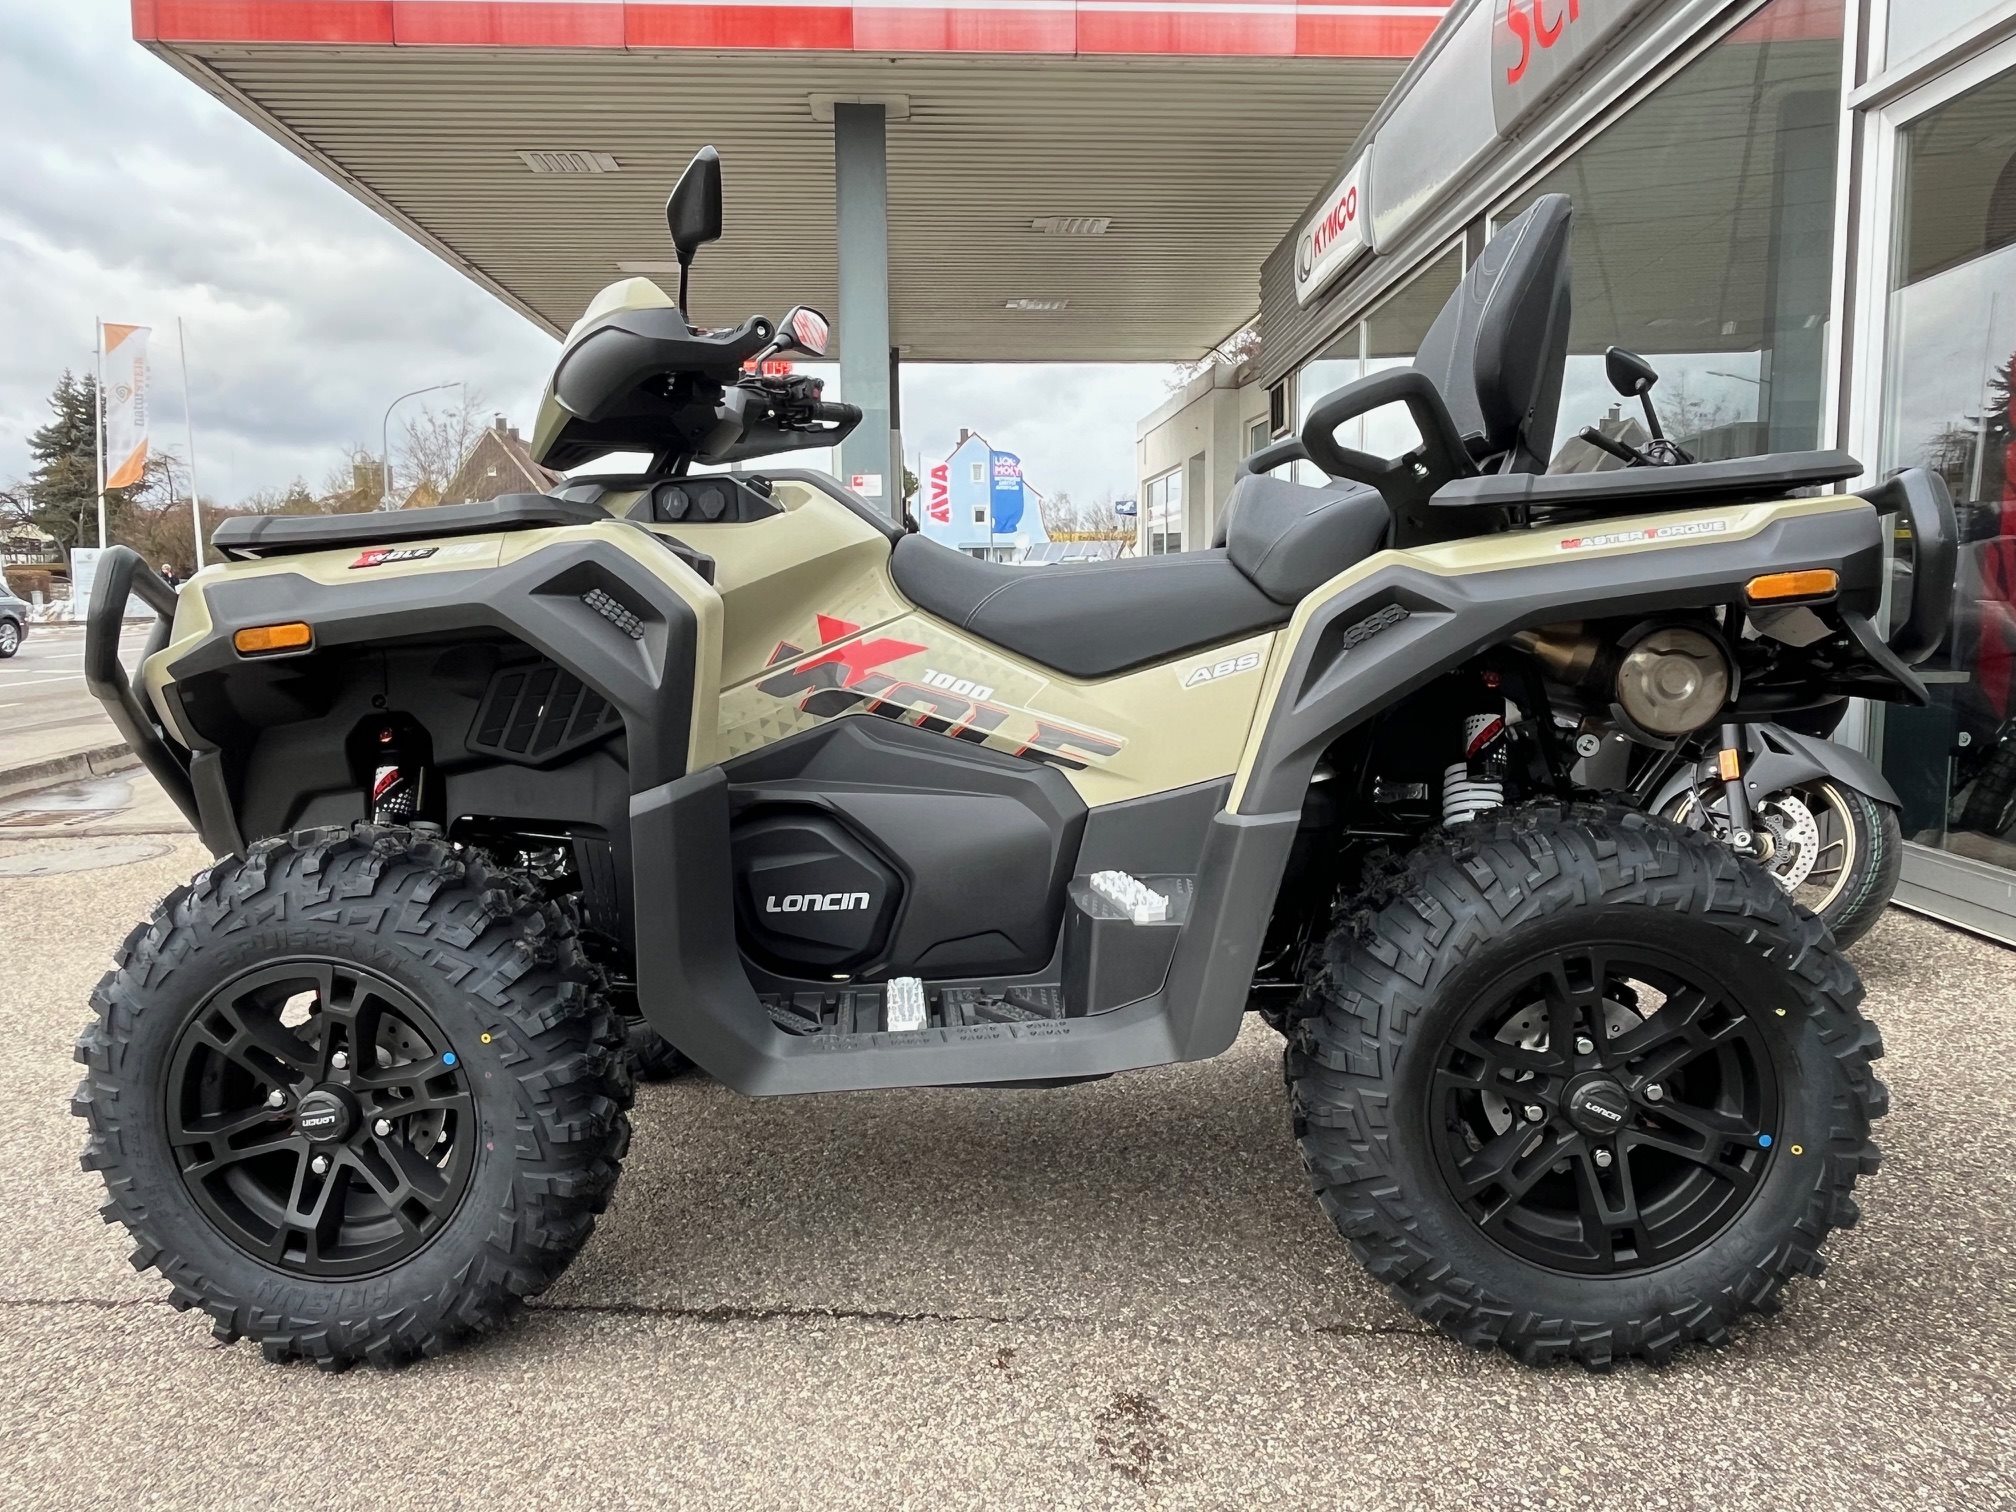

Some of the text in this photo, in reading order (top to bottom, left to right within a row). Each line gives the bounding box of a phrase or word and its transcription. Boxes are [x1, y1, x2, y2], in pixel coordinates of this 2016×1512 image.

[1314, 186, 1357, 258] KYMCO
[994, 465, 1022, 477] MOLY
[921, 669, 994, 700] 1000
[1185, 651, 1260, 688] ABS
[766, 892, 870, 913] LONCIN
